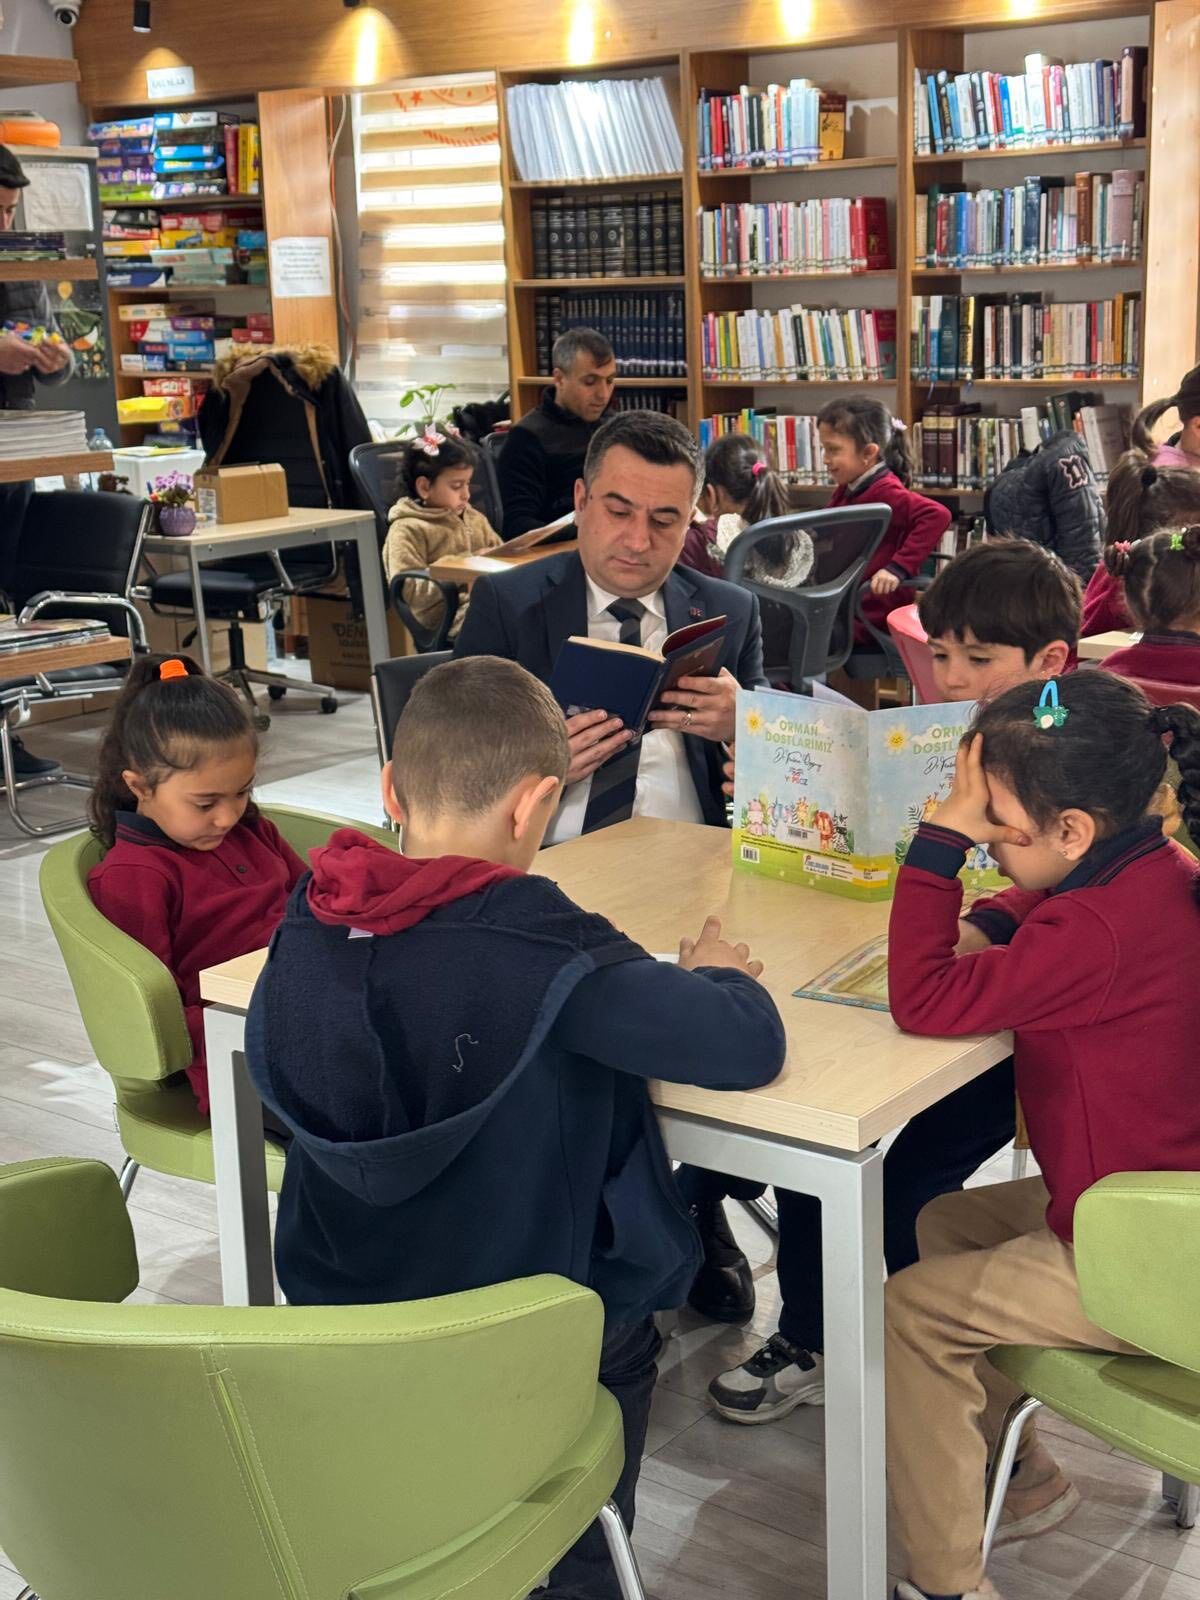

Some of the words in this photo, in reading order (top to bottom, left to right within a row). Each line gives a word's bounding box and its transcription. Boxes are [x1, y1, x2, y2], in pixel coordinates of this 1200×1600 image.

[779, 719, 819, 736] ORMAN
[931, 725, 963, 739] ORM
[913, 740, 956, 755] DOSTL
